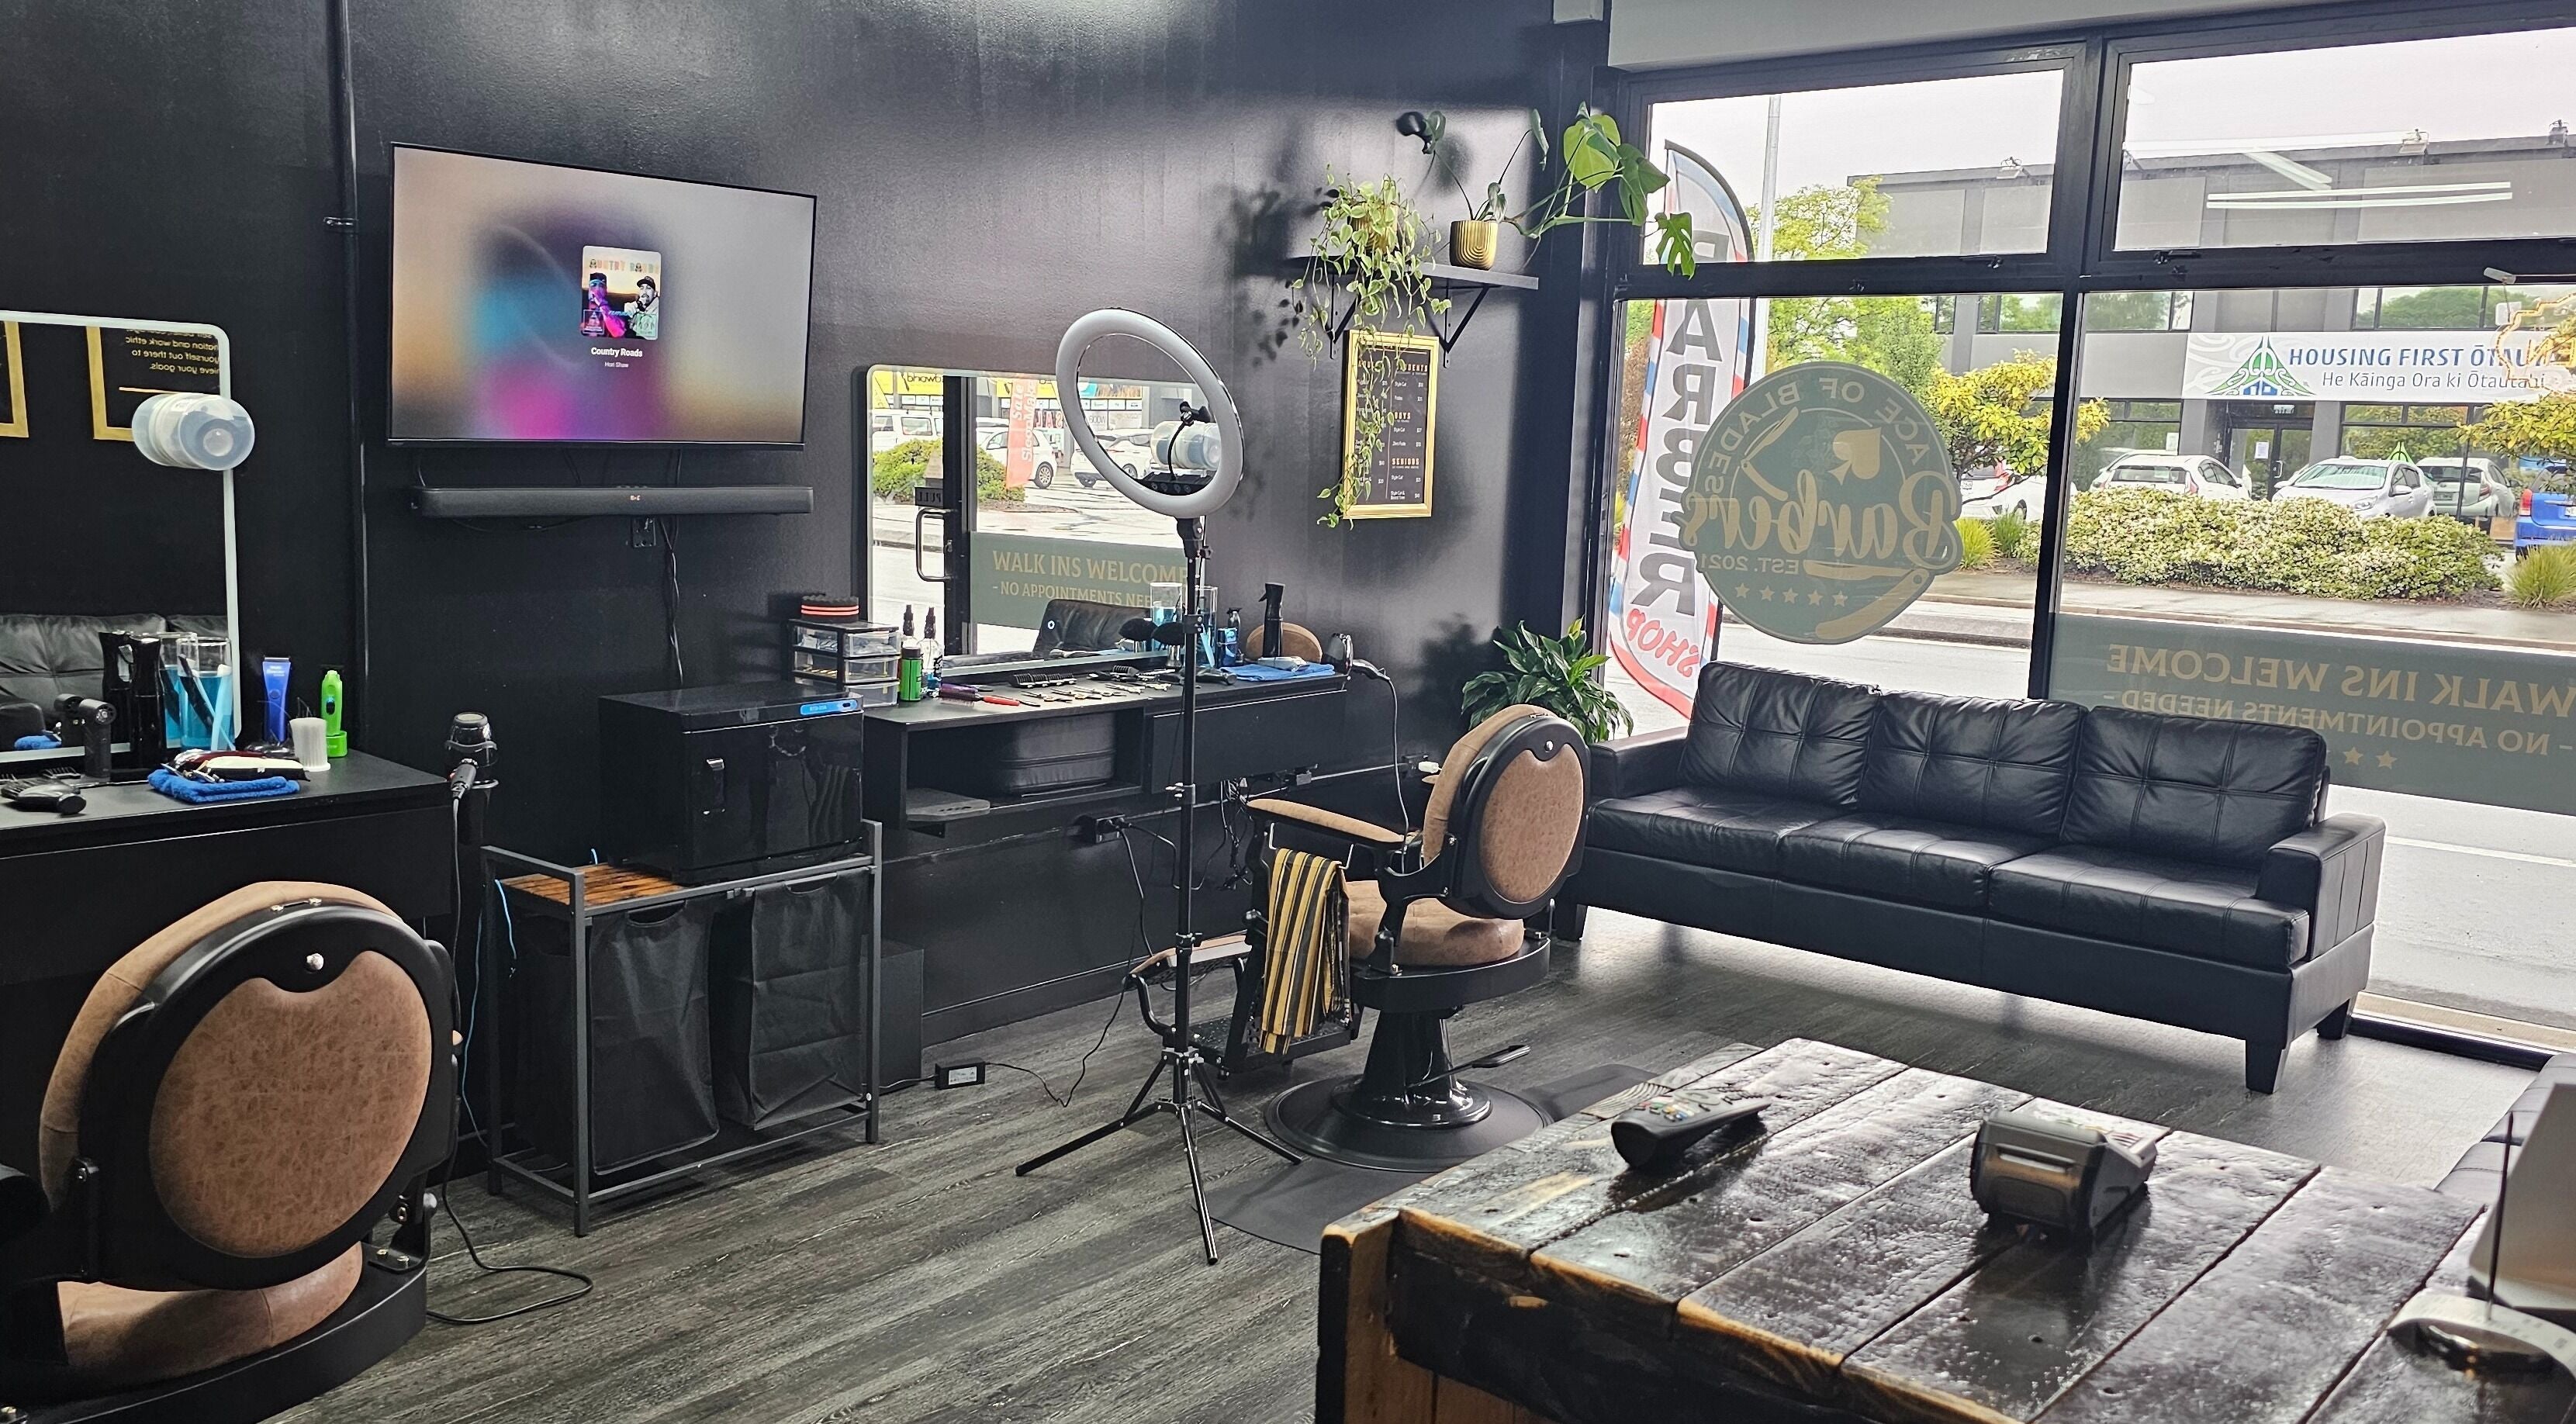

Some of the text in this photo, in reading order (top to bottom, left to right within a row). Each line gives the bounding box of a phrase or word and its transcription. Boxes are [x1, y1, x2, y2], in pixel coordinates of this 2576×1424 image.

[590, 347, 643, 358] Country Roads
[2289, 347, 2391, 366] HOUSING
[2398, 347, 2464, 366] FIRST
[2322, 372, 2343, 386] He
[2350, 372, 2406, 391] Kāinga
[2412, 372, 2440, 388] Ora
[2447, 372, 2460, 388] ki
[992, 549, 1188, 586] WALK INS WELCOME
[1000, 581, 1020, 596] NO
[1022, 582, 1123, 607] APPOINTMENTS
